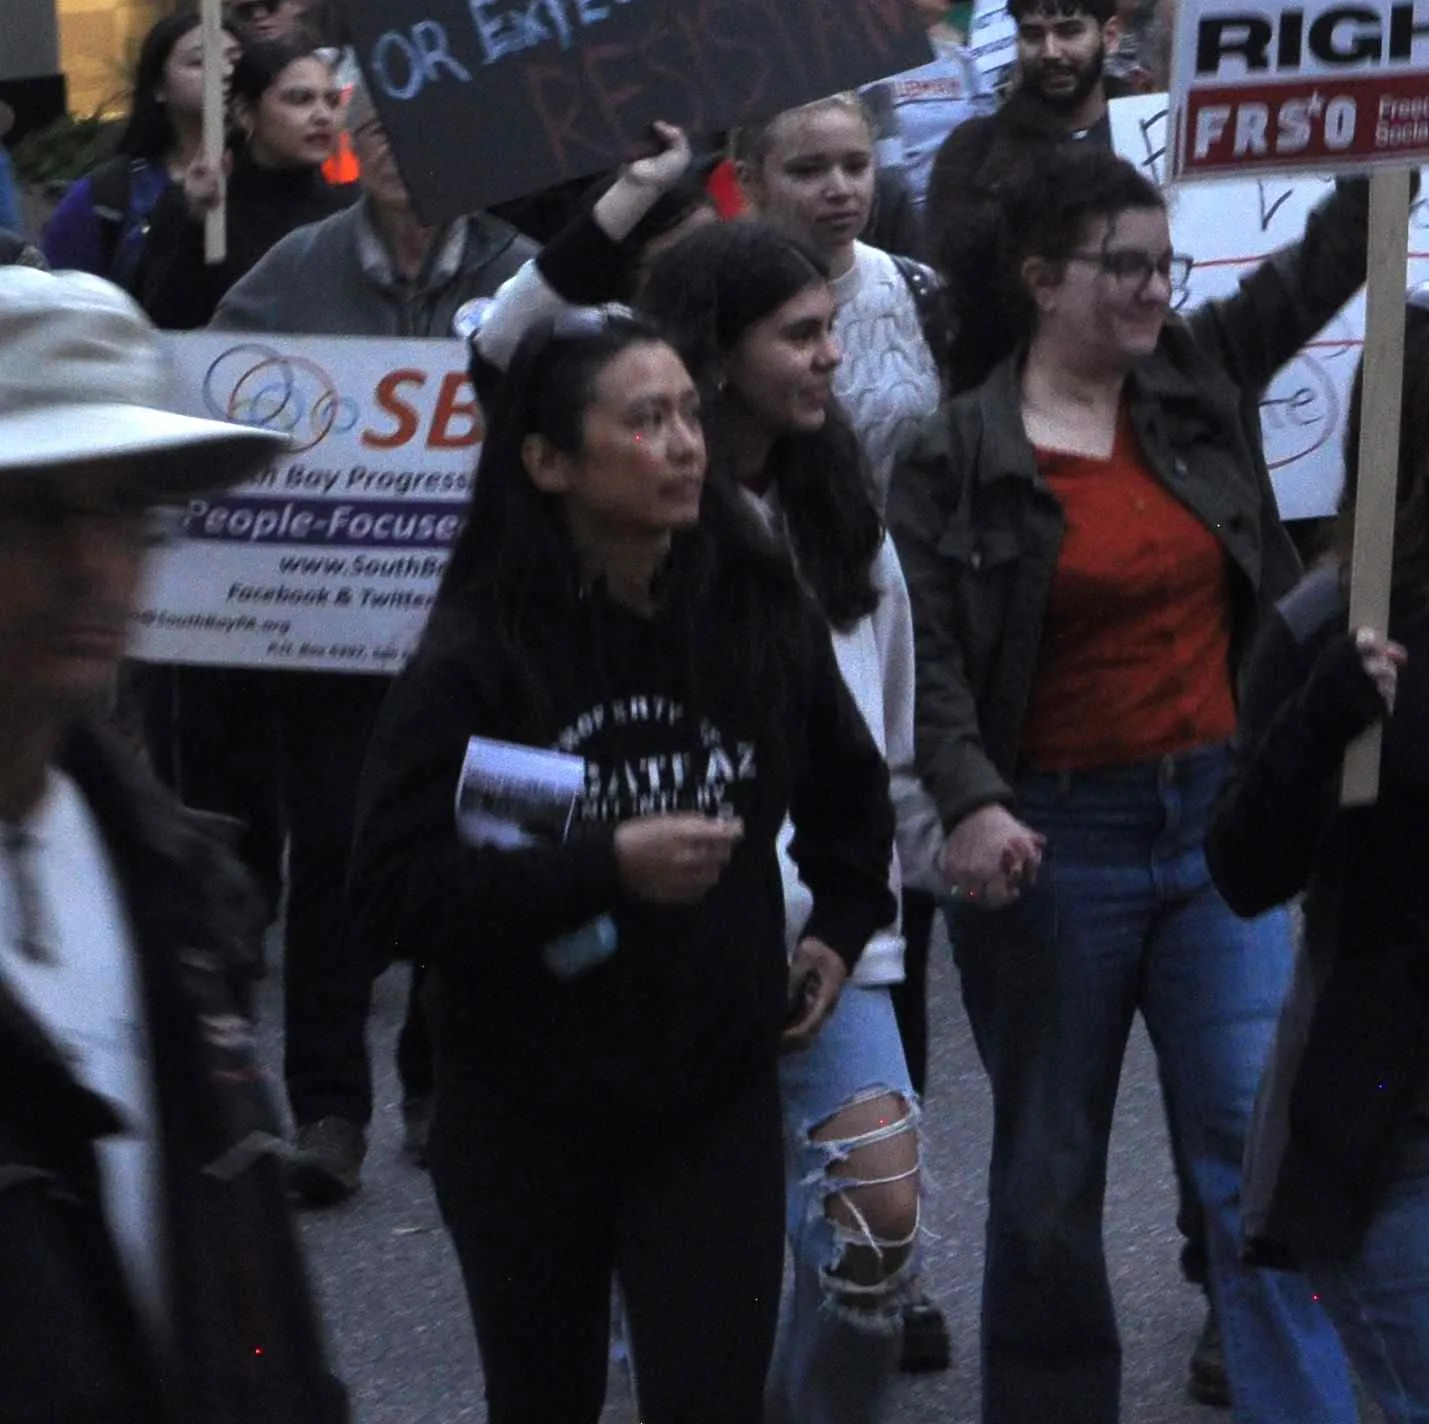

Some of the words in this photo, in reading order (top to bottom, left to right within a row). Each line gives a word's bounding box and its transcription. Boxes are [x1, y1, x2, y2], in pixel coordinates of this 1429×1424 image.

[372, 21, 471, 100] OR
[287, 463, 341, 495] Bay
[346, 464, 472, 496] Progress
[183, 497, 463, 543] People-Focuse
[226, 580, 328, 604] Facebook
[334, 586, 352, 604] &
